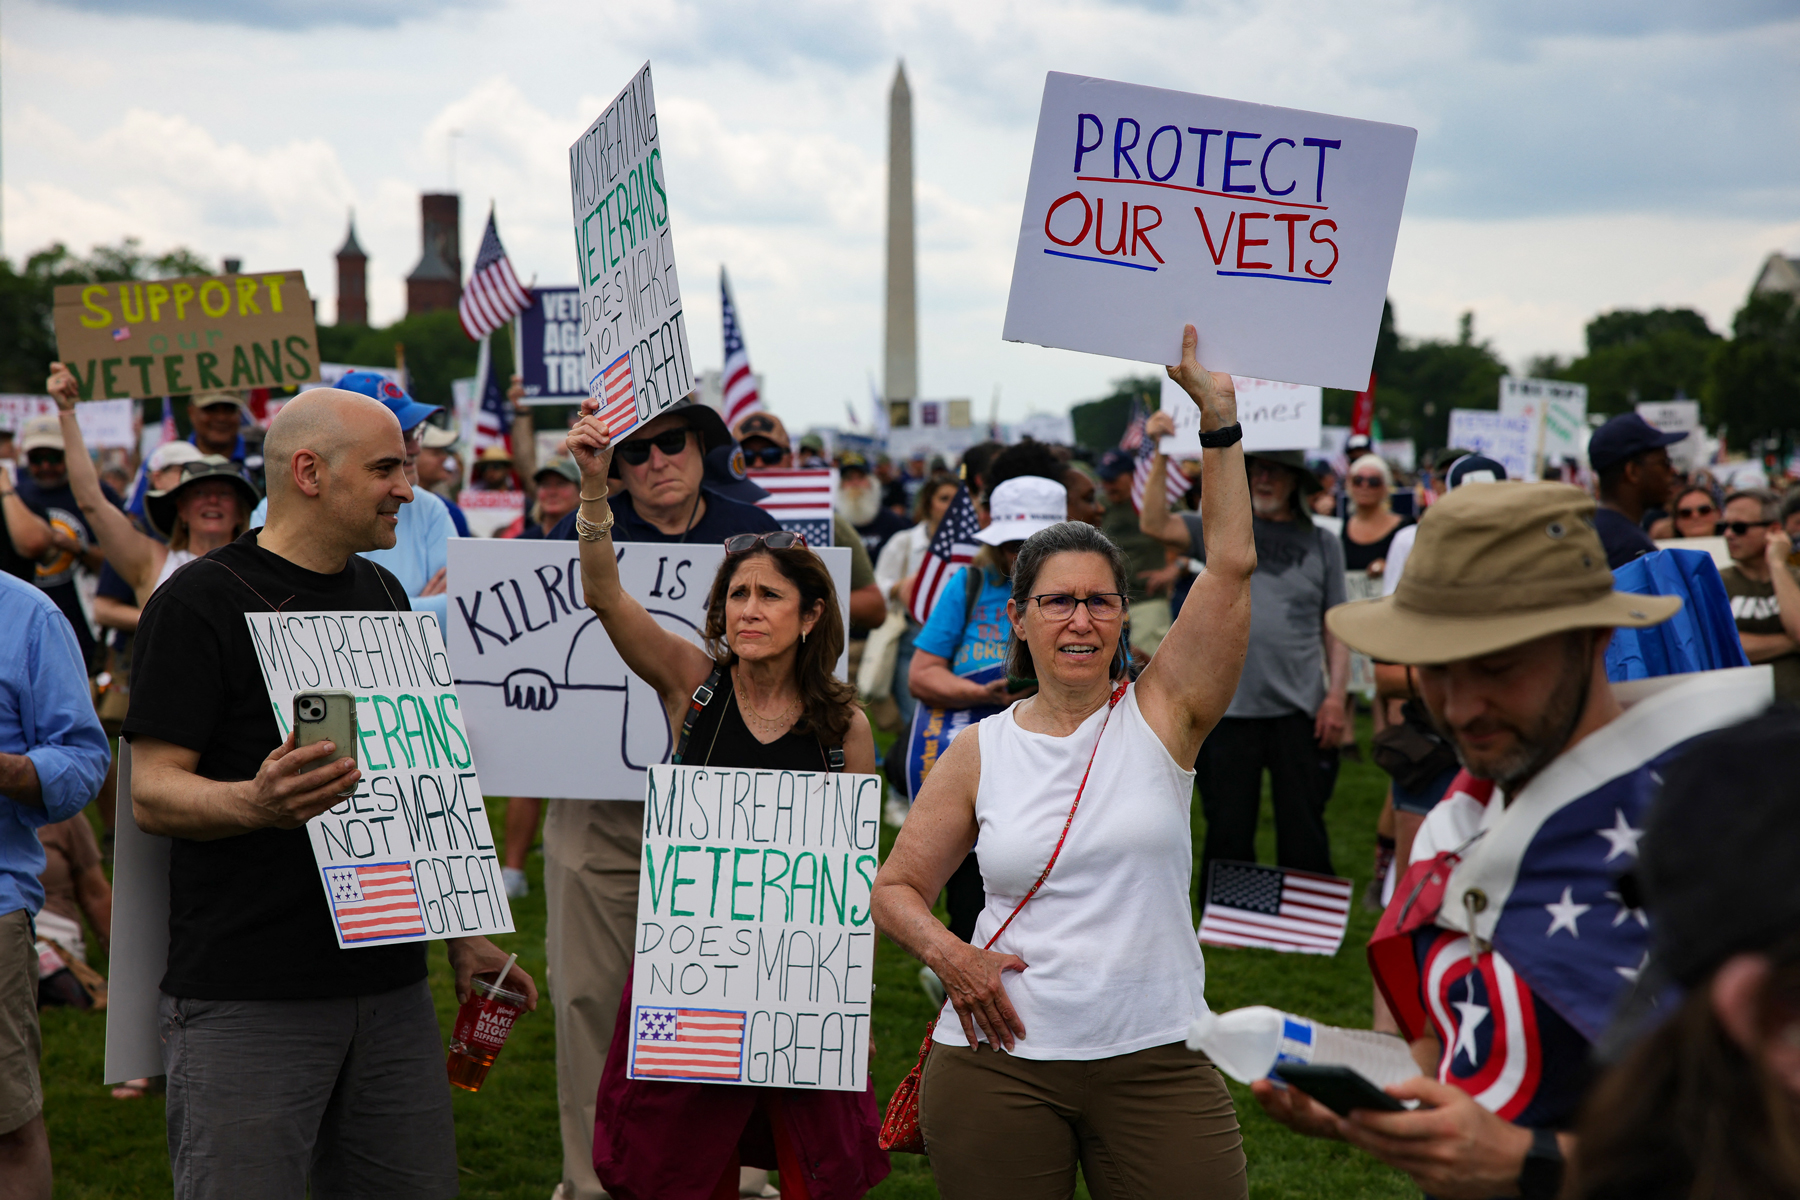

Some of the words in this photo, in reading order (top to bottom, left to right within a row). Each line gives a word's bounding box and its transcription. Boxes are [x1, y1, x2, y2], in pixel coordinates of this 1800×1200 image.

[570, 66, 657, 219] MISTREATING
[1073, 113, 1342, 203] PROTECT
[575, 147, 667, 294] VETERANS
[1044, 190, 1165, 264] OUR
[1194, 206, 1339, 278] VETS
[80, 274, 286, 329] SUPPORT
[541, 291, 581, 320] VET
[582, 270, 624, 336] DOES
[589, 311, 622, 369] NOT
[624, 227, 678, 336] MAKE
[67, 334, 312, 401] VETERANS
[148, 328, 223, 354] our
[631, 309, 689, 421] GREAT
[456, 547, 625, 654] KILRO
[649, 556, 691, 600] IS
[249, 615, 452, 691] MISTREATING
[273, 693, 472, 770] ERANS
[923, 707, 945, 738] Servi
[320, 815, 394, 861] NOT
[393, 772, 494, 852] MAKE
[645, 767, 878, 850] MISTREATING
[415, 854, 507, 934] GREAT
[645, 843, 877, 927] VETERANS
[637, 922, 752, 957] DOES
[650, 962, 739, 997] NOT
[756, 927, 871, 1005] MAKE
[473, 1030, 505, 1045] DIFFEREN
[479, 1010, 513, 1028] MAKE
[747, 1010, 870, 1086] GREAT
